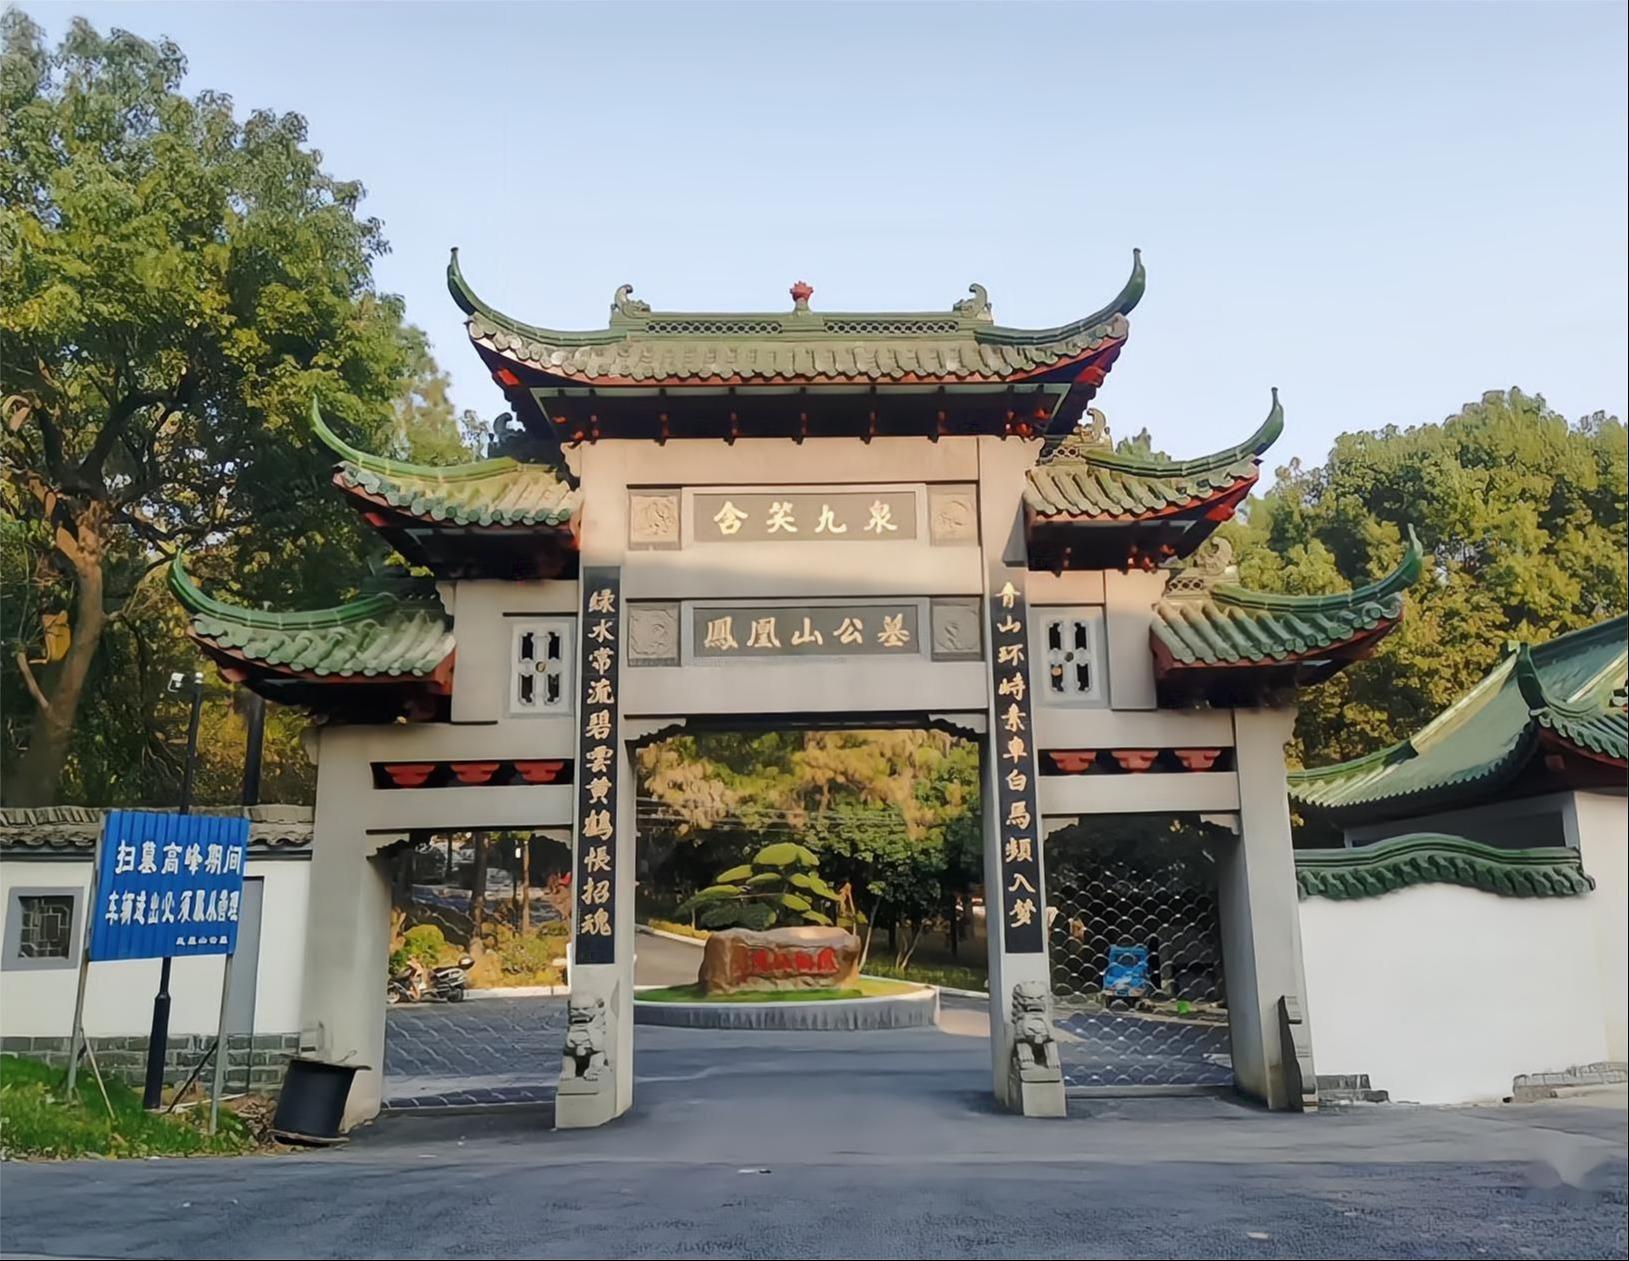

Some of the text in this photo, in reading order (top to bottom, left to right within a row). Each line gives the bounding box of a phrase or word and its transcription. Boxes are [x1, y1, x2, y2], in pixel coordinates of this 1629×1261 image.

[713, 499, 898, 535] 含笑九泉
[704, 613, 911, 651] 鳳凰山公墓
[115, 839, 243, 876] 扫墓高峰期间
